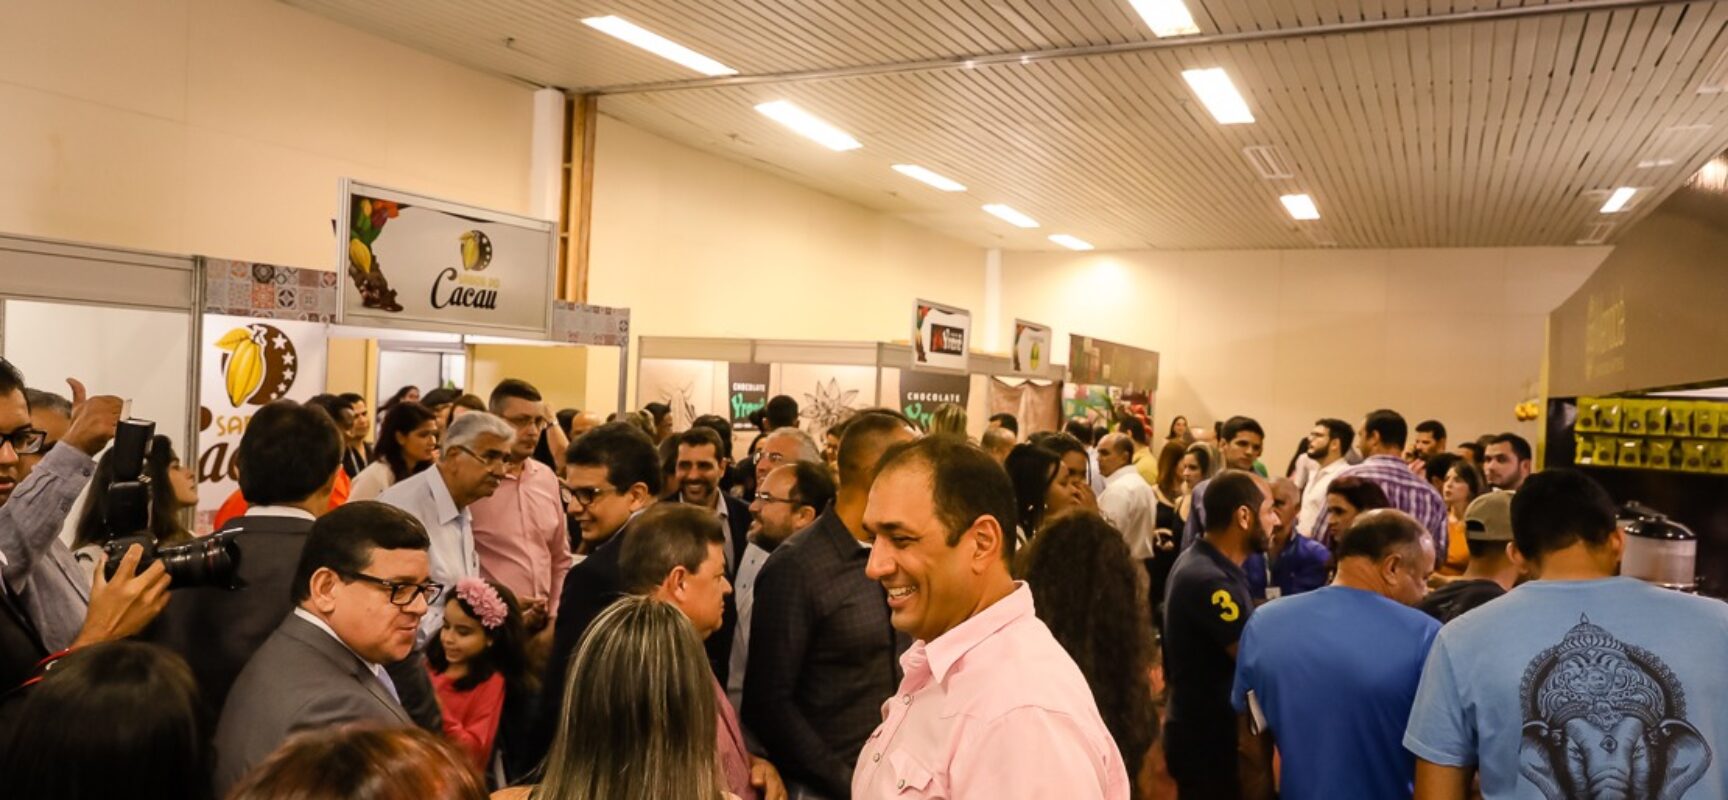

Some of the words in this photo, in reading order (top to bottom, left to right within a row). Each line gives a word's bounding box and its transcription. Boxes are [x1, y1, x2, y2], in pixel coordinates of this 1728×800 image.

[431, 267, 498, 310] Cacau
[733, 382, 766, 392] CHOCOLATE
[907, 391, 960, 403] CHOCOLATE
[1211, 589, 1239, 622] 3
